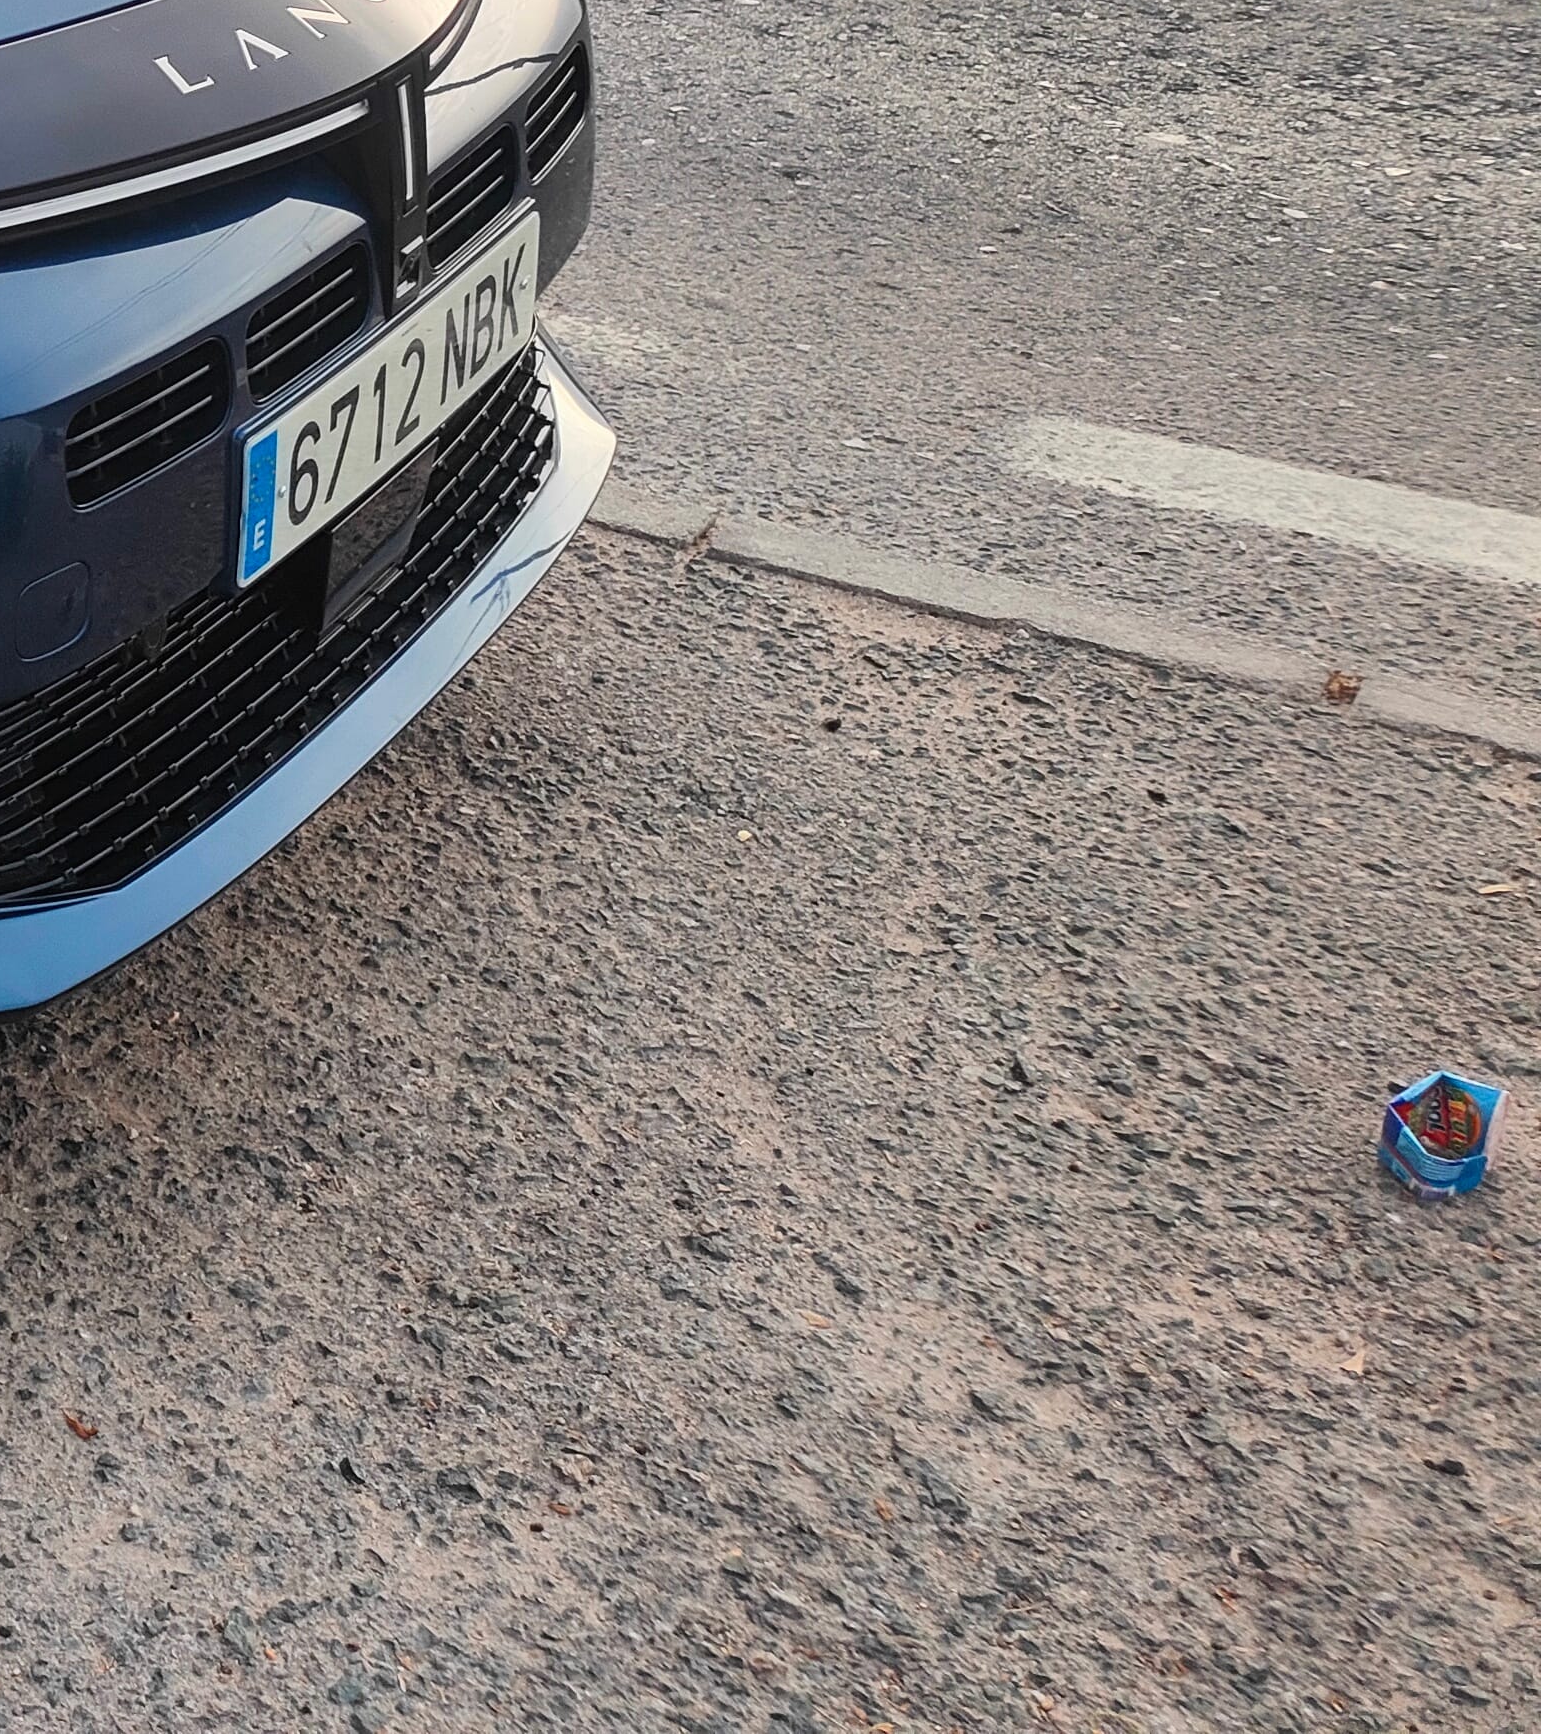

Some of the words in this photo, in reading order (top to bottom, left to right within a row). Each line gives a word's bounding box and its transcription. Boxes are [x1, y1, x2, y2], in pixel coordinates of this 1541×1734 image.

[284, 339, 427, 527] 6712
[437, 240, 530, 413] NBK
[253, 518, 266, 551] E
